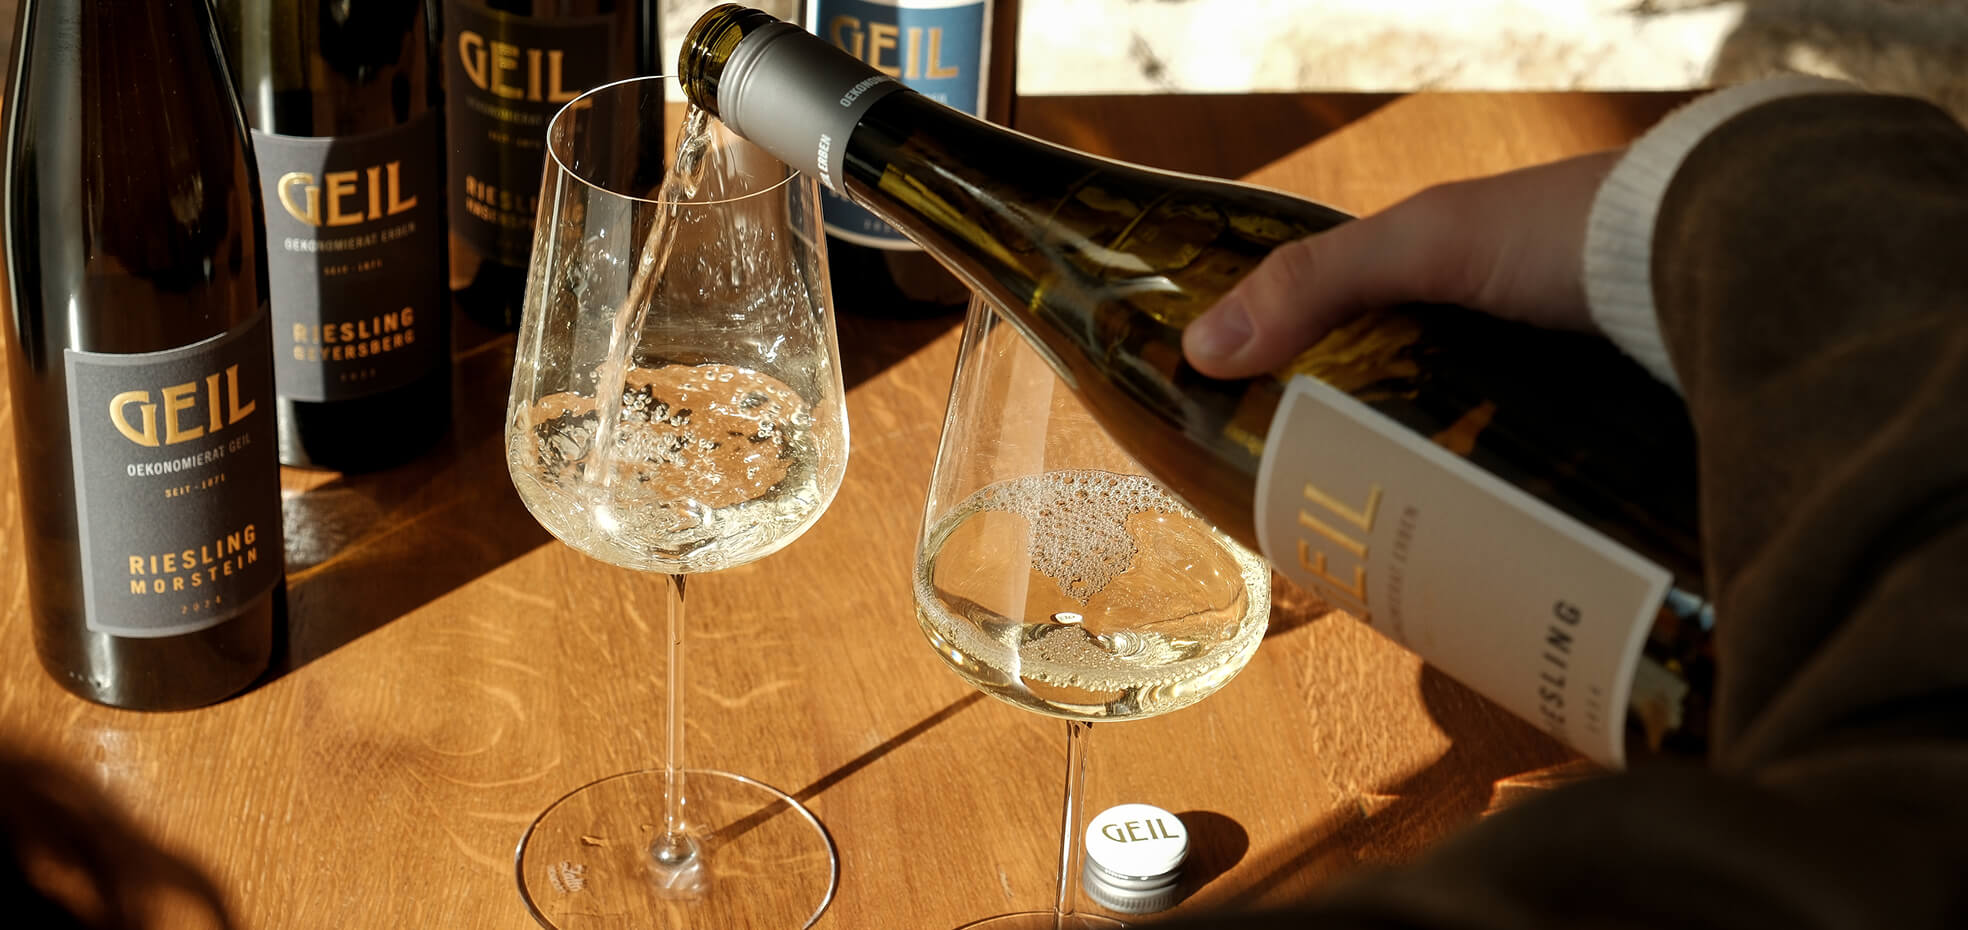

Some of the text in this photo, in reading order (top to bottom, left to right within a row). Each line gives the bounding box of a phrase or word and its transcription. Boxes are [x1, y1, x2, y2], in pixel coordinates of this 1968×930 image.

[458, 31, 593, 108] GEIL
[831, 16, 959, 79] GEIL
[817, 134, 832, 172] ERBEN
[277, 161, 417, 227] GEIL
[293, 306, 415, 344] RIESLING
[109, 363, 256, 447] GEIL
[127, 433, 252, 477] OEKONOMIERAT GEIL
[165, 484, 190, 498] SEIT
[129, 524, 257, 576] RIESLING
[130, 548, 258, 595] MORSTEIN
[1537, 599, 1583, 732] ESLING
[1101, 818, 1180, 843] GEIL
